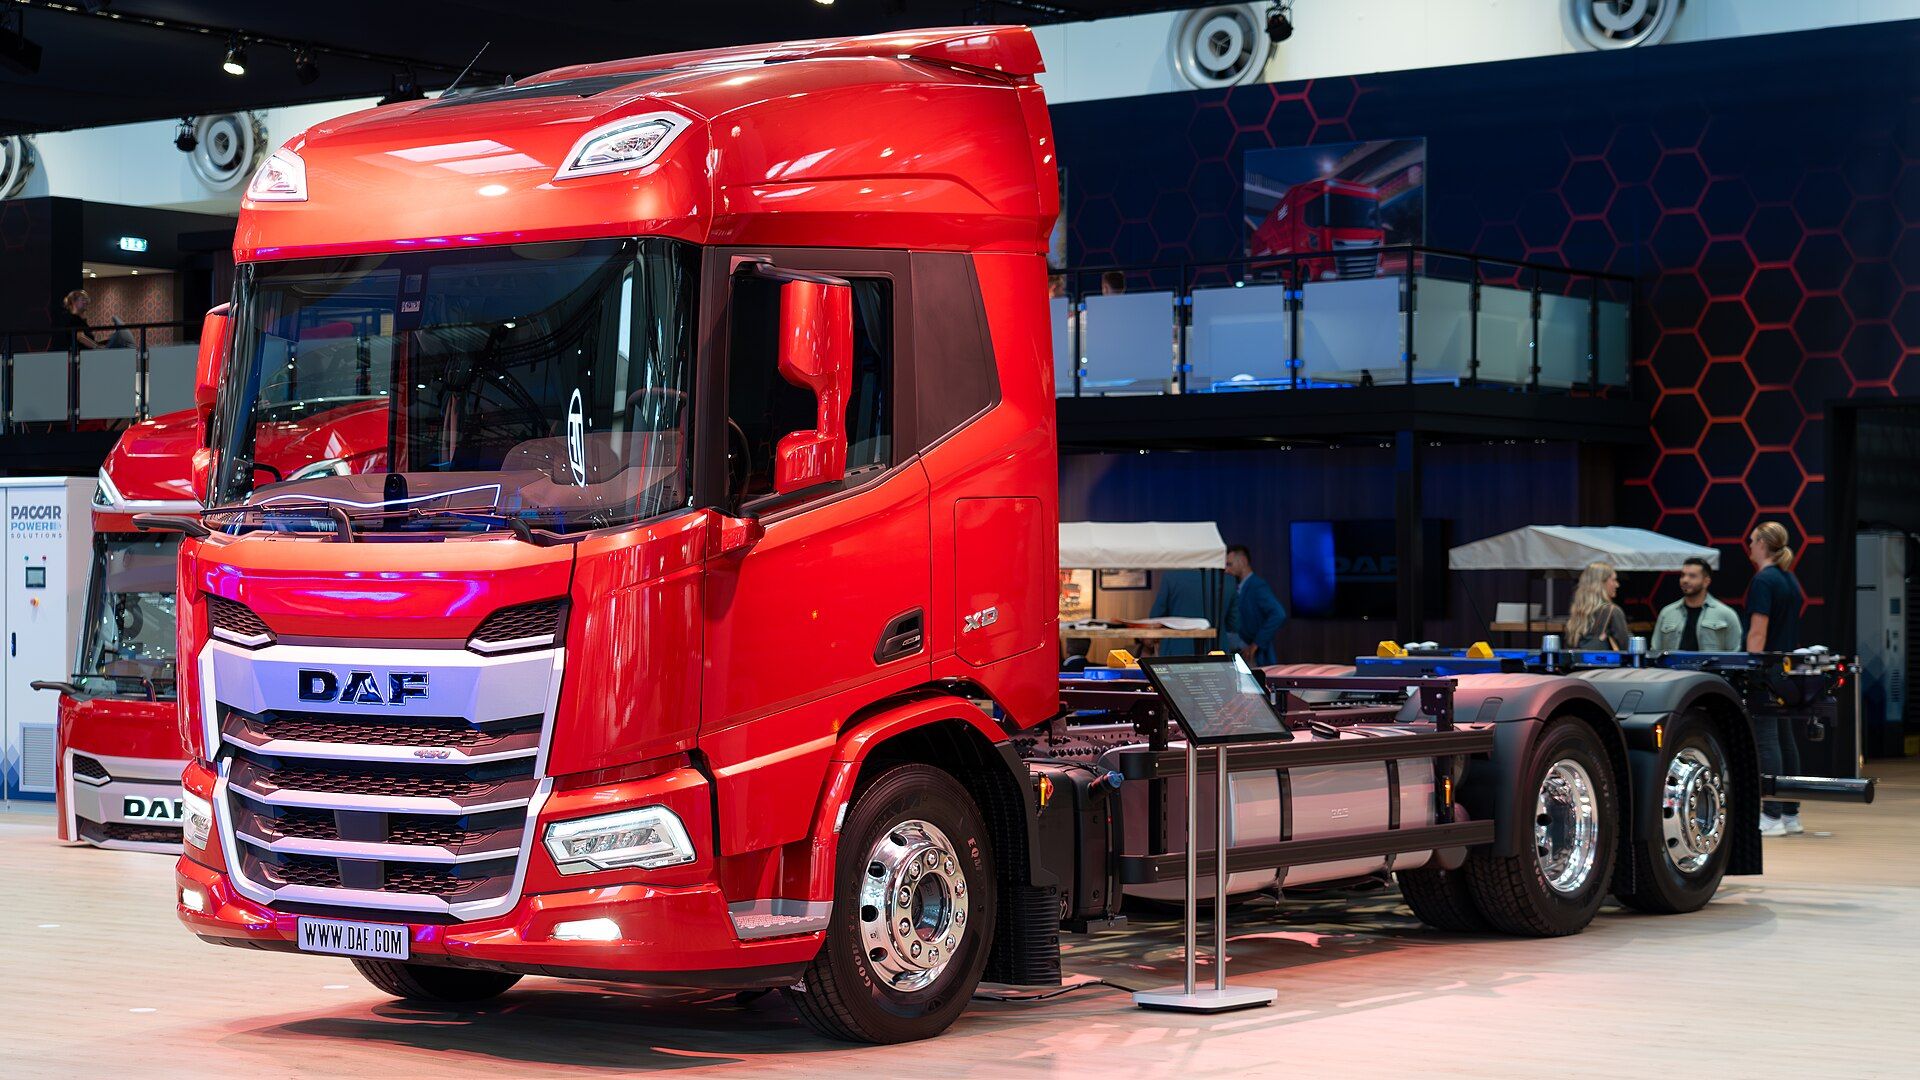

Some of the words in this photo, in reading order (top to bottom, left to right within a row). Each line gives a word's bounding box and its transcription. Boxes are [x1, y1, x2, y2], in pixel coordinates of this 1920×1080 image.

[11, 505, 62, 520] PACCAR
[11, 522, 51, 531] POWER
[962, 606, 998, 633] XD
[298, 668, 430, 706] DAF
[304, 922, 403, 955] WWW.DAF.COM
